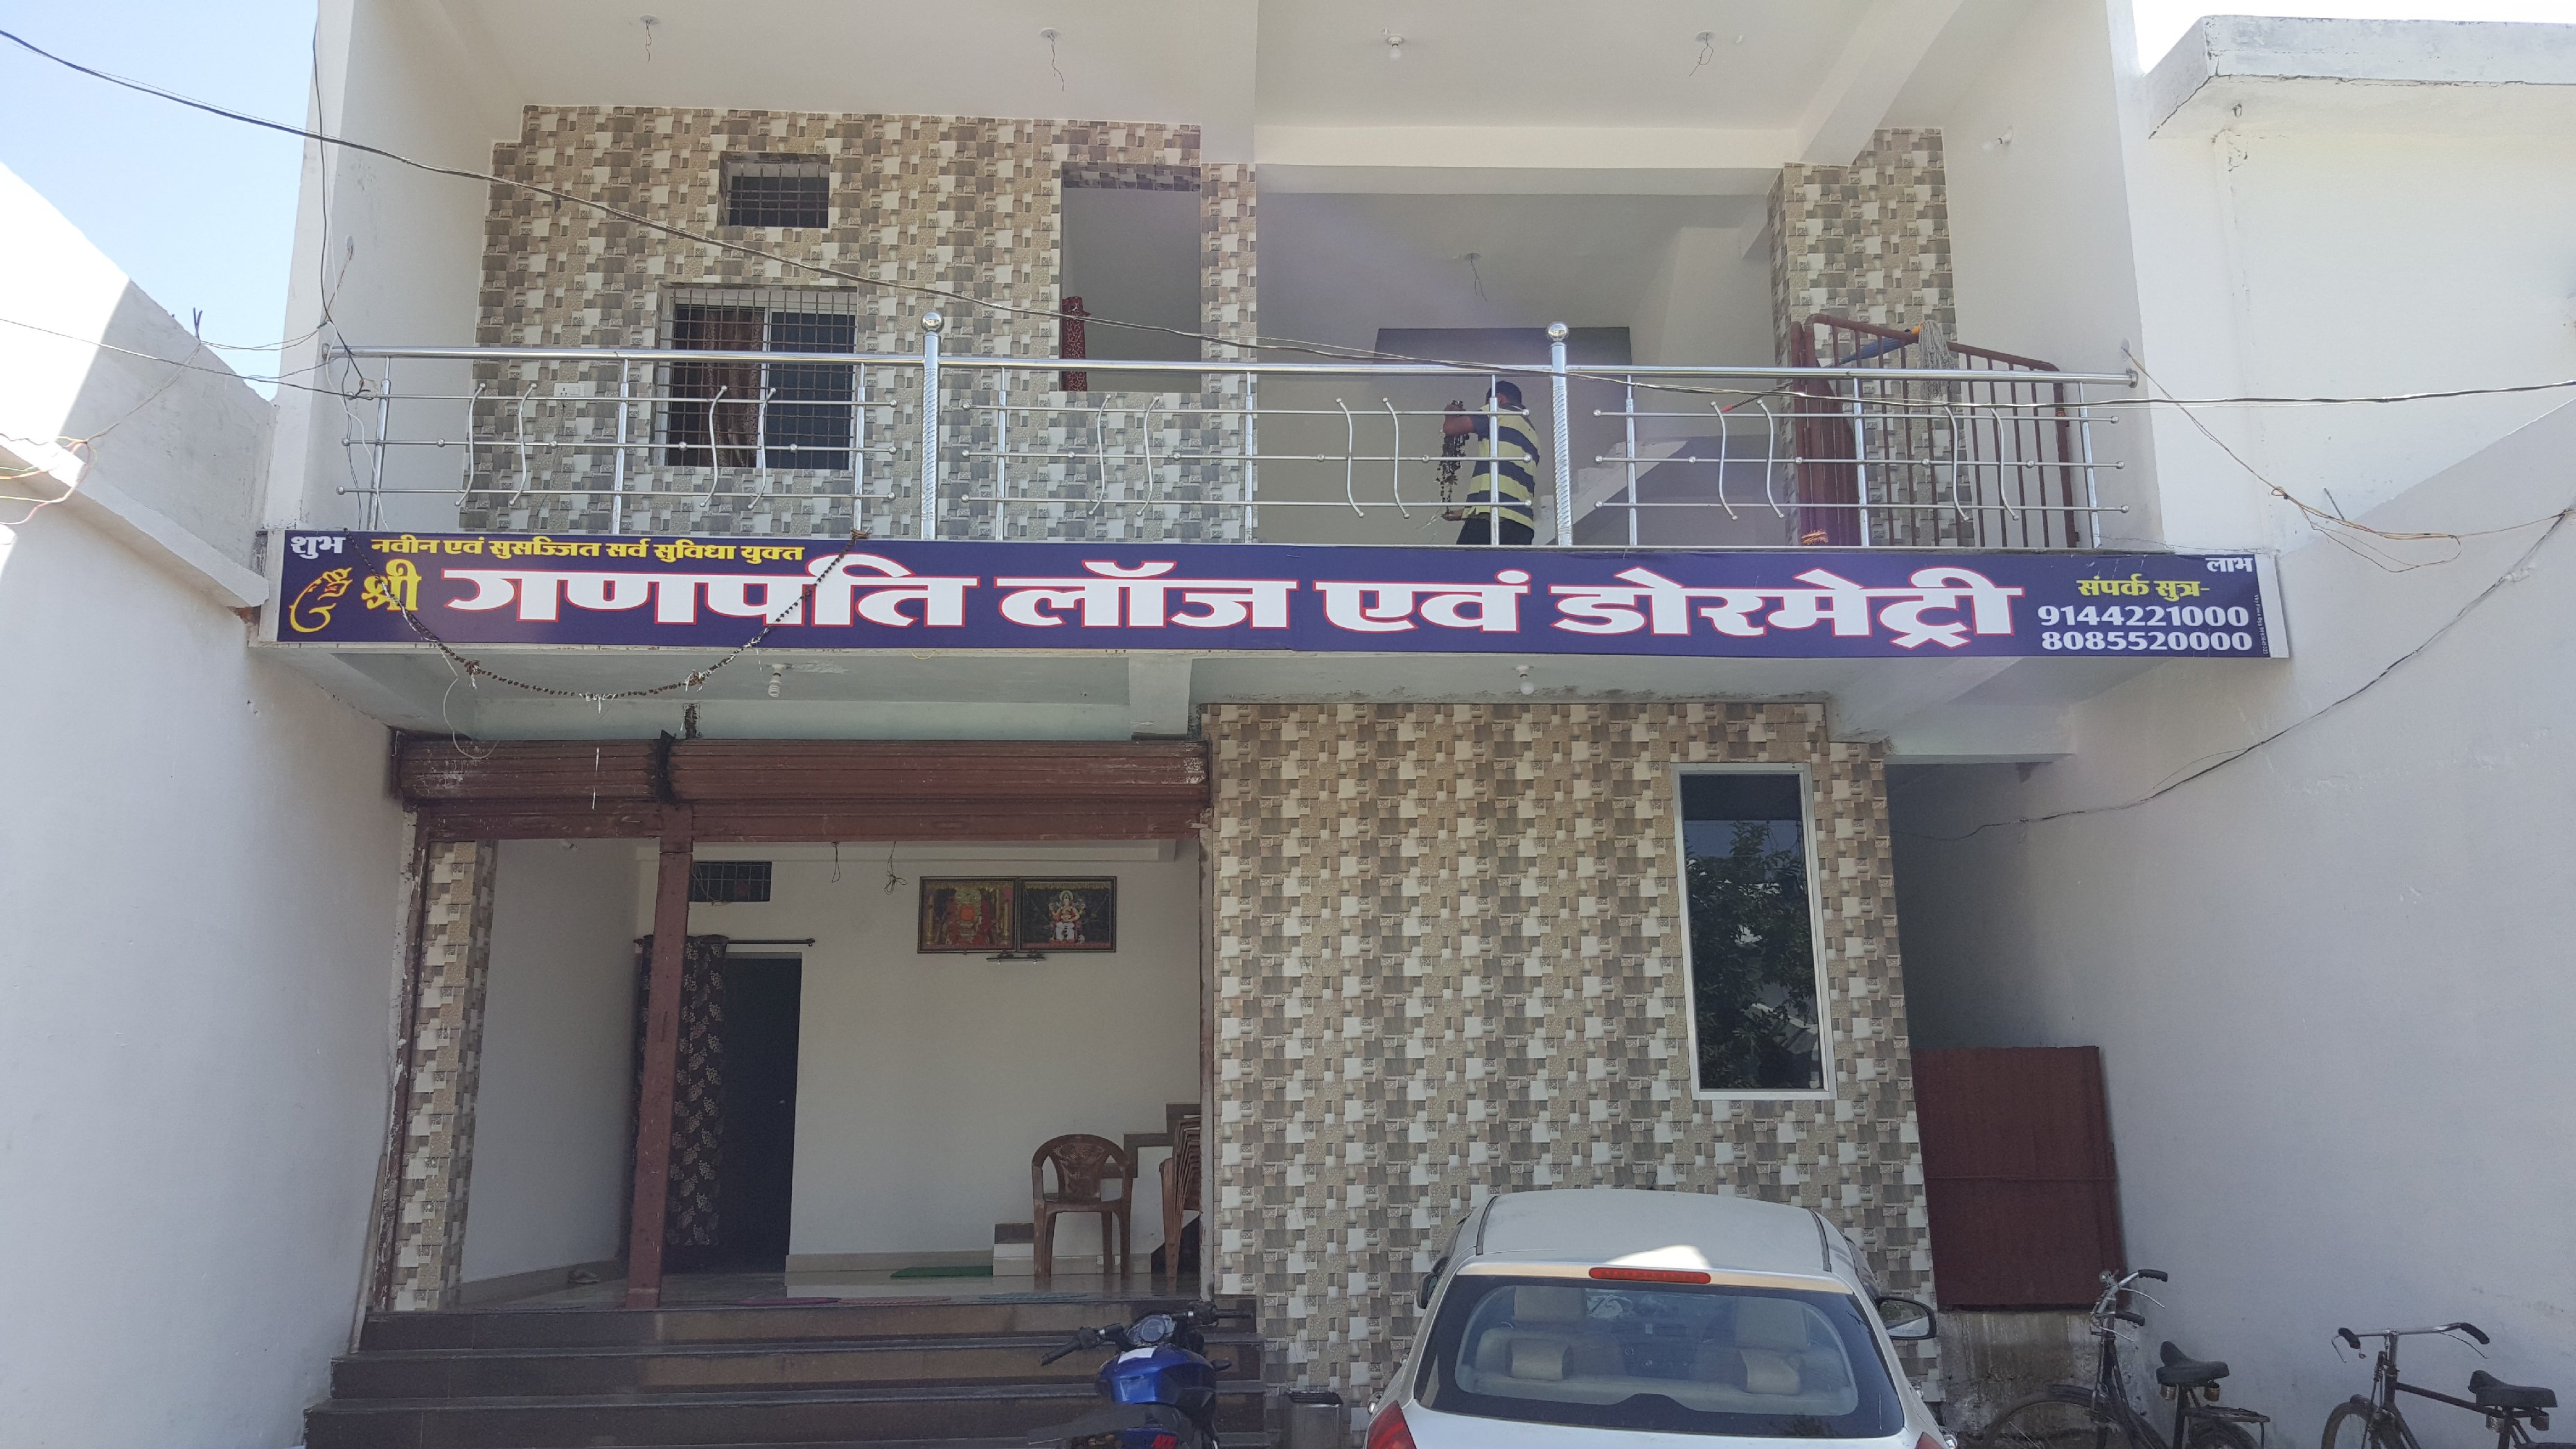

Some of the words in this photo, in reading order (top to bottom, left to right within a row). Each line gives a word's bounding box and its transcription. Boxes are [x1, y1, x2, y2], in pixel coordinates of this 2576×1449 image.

[290, 536, 346, 559] शुभ
[371, 534, 441, 554] नवीन
[442, 536, 484, 555] एवं
[488, 536, 601, 559] सुसज्जित
[606, 538, 651, 559] सर्व
[653, 538, 736, 563] सुविधा
[741, 545, 806, 564] युक्त
[2205, 557, 2254, 573] लाभ
[2076, 573, 2150, 597] संपर्क
[360, 558, 422, 612] श्री
[441, 554, 981, 628] गणपति
[993, 559, 1299, 630] लॉज
[1312, 569, 1530, 633] एवं
[1548, 566, 2025, 649] डोरमेट्री
[2038, 606, 2250, 627] 9144221000
[2041, 631, 2252, 651] 8085520000
